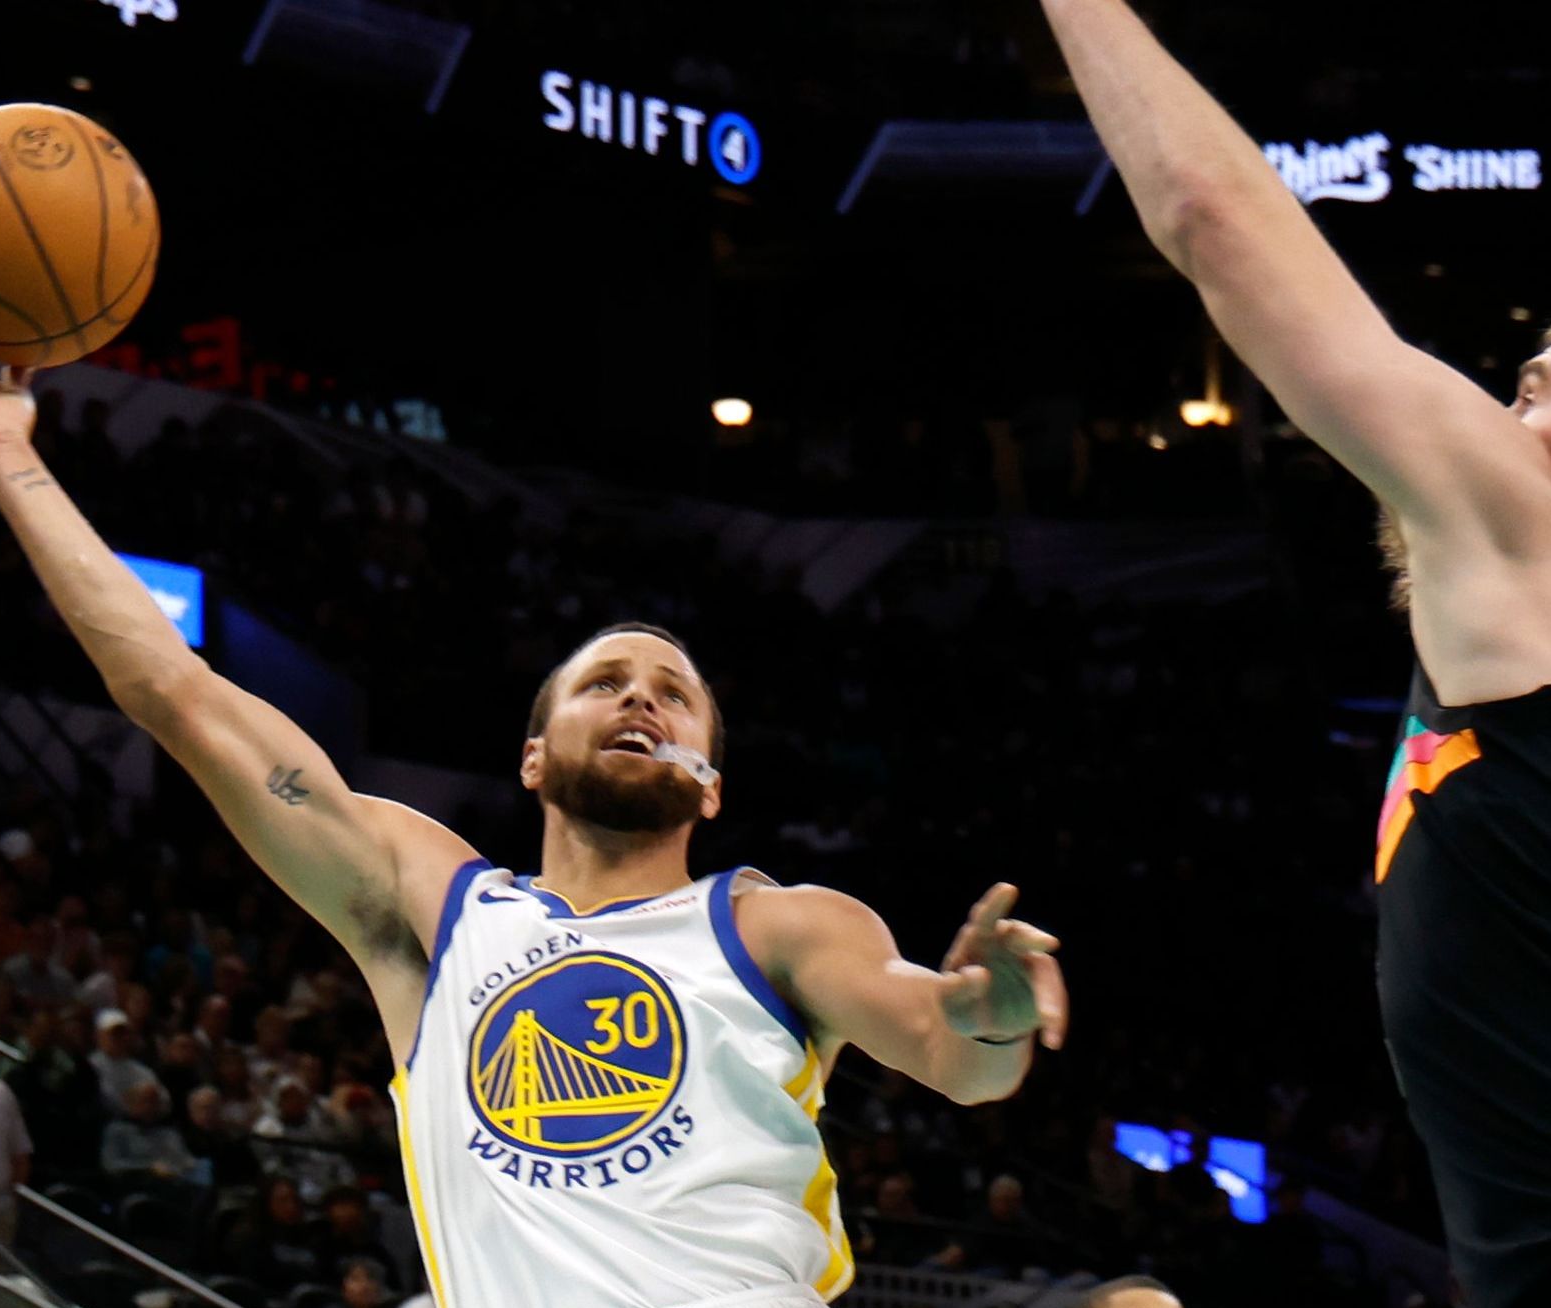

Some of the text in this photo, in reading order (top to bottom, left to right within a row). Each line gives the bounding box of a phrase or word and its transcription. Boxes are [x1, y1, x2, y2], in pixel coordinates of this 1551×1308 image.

[469, 930, 585, 1008] GOLDEN
[584, 990, 659, 1057] 30
[465, 1103, 696, 1189] WARRIORS
